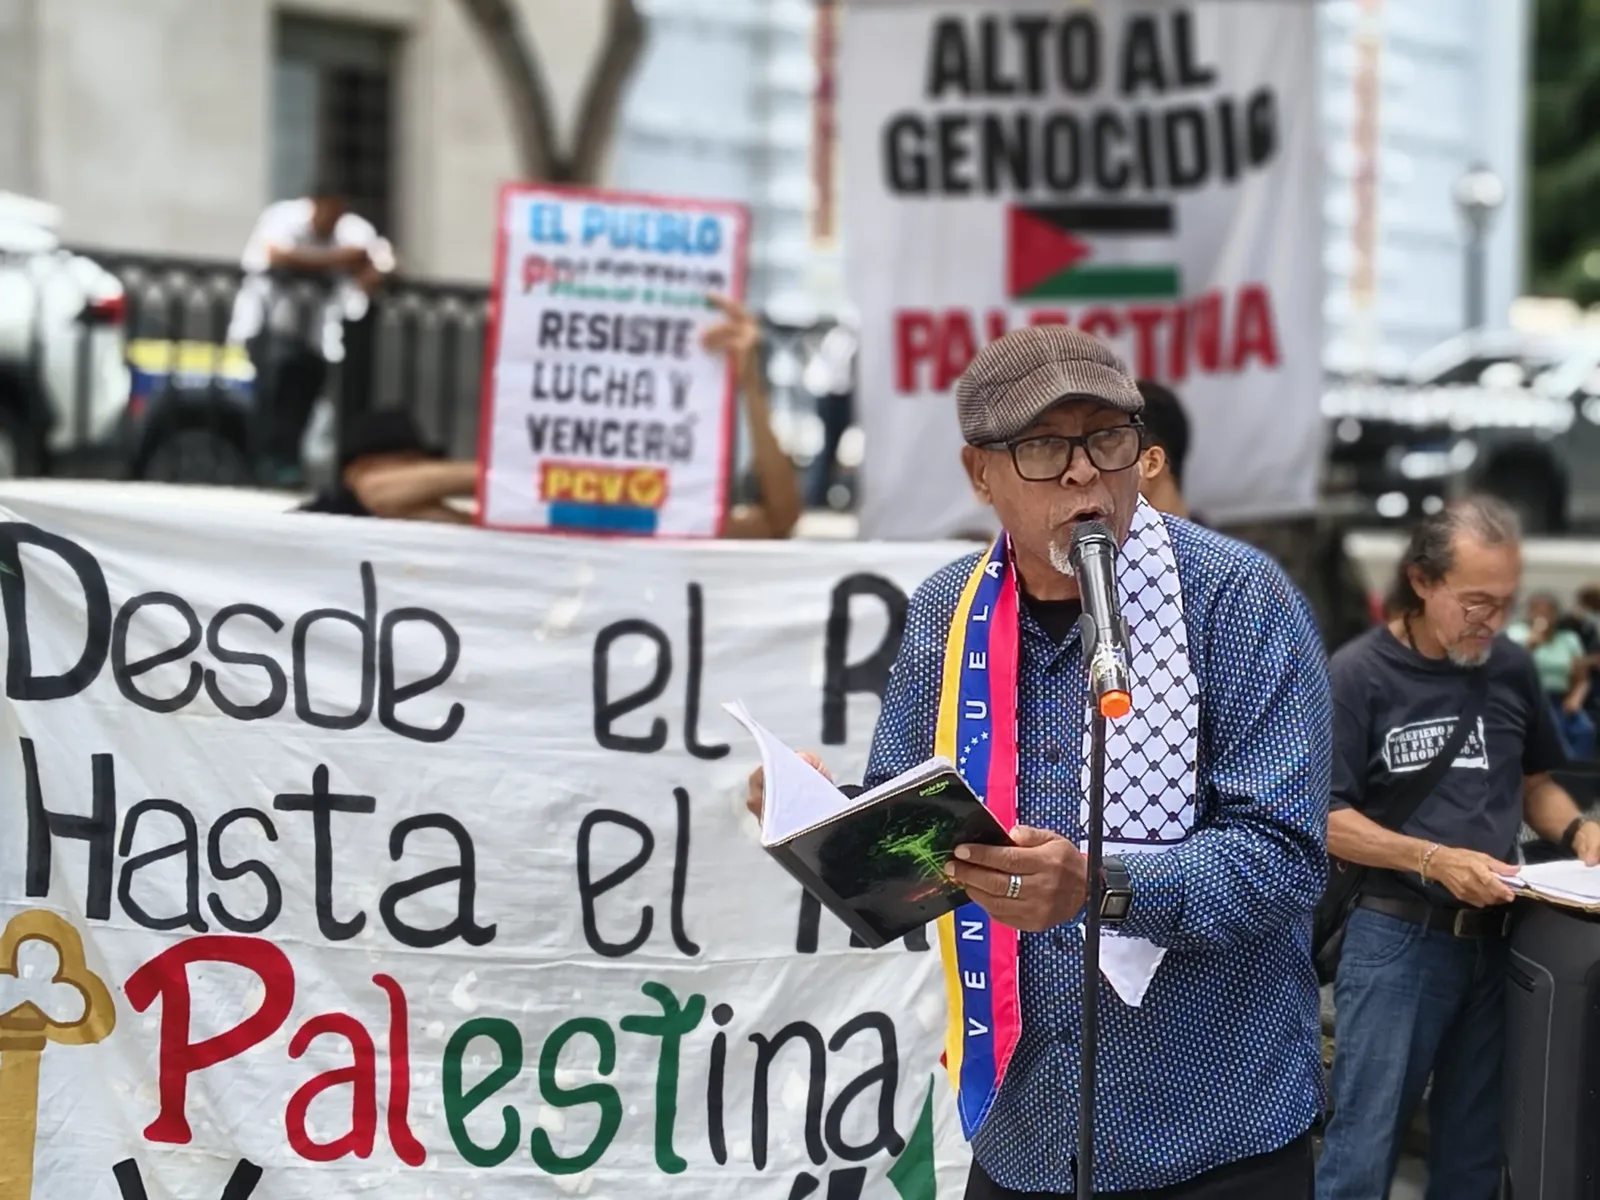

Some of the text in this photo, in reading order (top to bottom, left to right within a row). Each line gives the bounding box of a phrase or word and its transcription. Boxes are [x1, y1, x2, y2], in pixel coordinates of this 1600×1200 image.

[926, 9, 1218, 99] ALTO AL
[883, 85, 1280, 196] GENOCIDIO
[528, 202, 568, 245] EL
[537, 309, 695, 360] RESISTE
[892, 282, 1280, 395] PATINA
[530, 360, 693, 411] LUCHA Y
[547, 467, 624, 504] PCV
[0, 521, 465, 743] Desde
[593, 582, 731, 760] el
[1394, 742, 1408, 755] DE
[1411, 737, 1434, 751] PIE
[20, 737, 497, 949] Hasta
[577, 786, 701, 958] el
[124, 935, 906, 1174] Palestina
